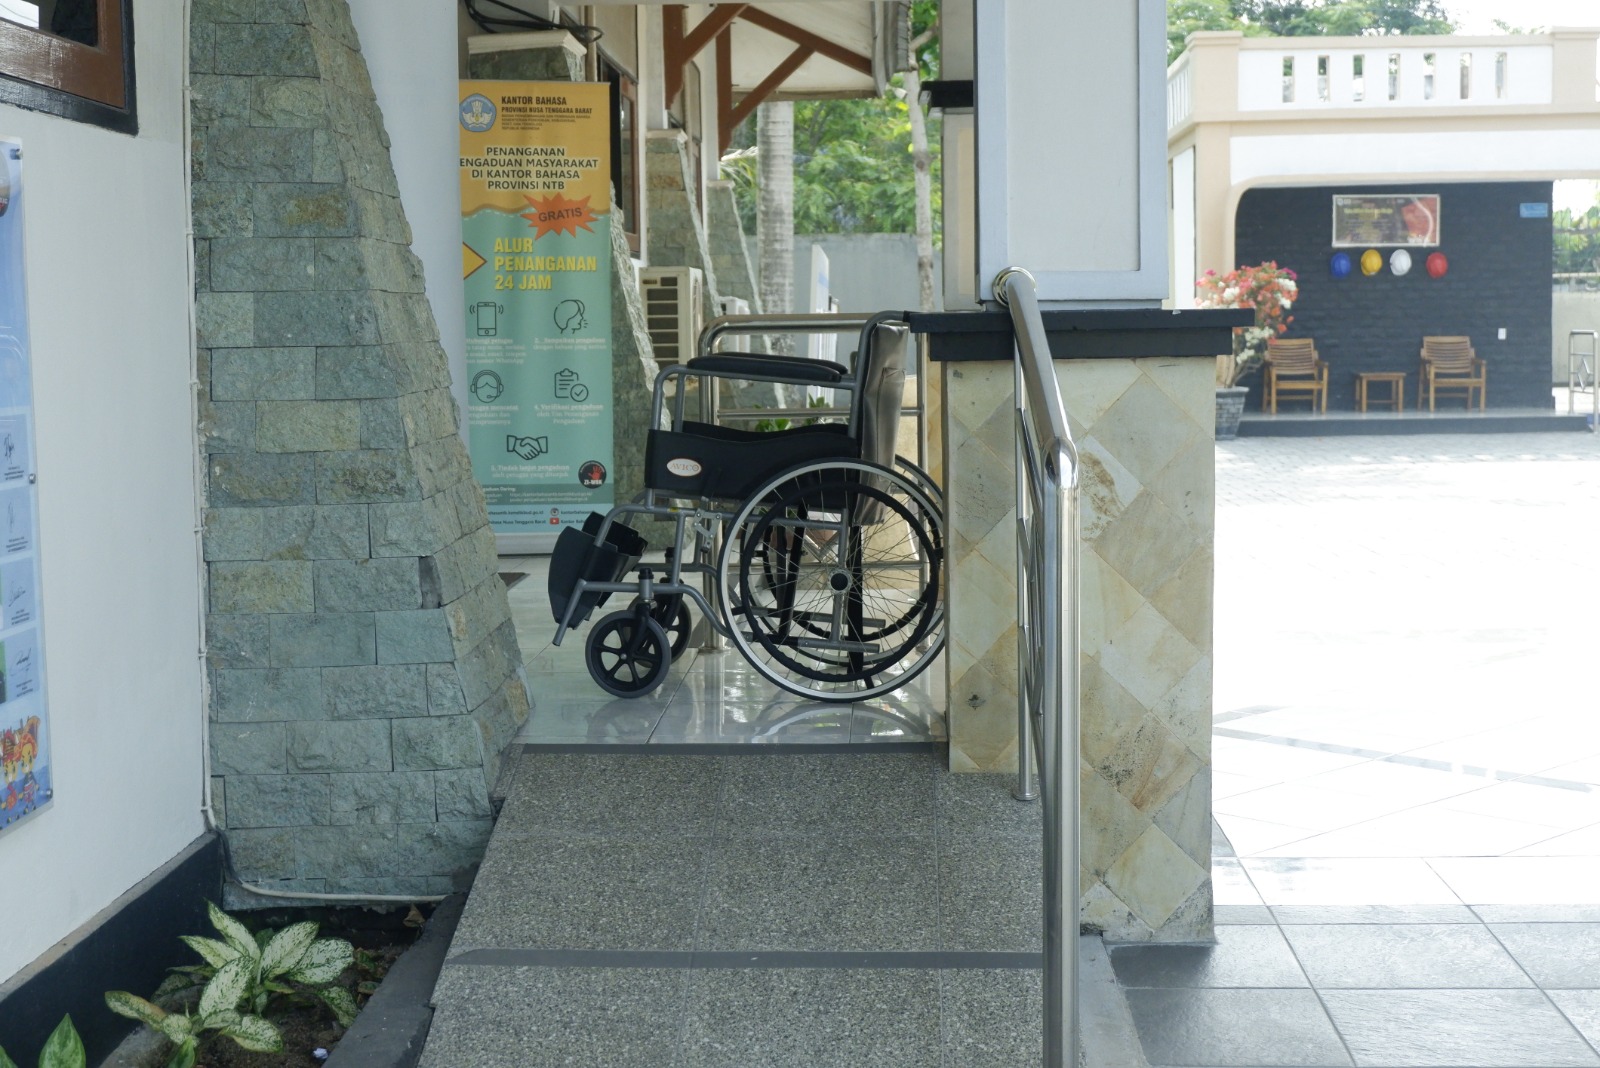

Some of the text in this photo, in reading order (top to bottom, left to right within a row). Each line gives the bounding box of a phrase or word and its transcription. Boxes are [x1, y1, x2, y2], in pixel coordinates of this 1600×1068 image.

[501, 96, 567, 105] KANTOR BAHASA
[486, 147, 565, 156] PENANGANAN
[459, 158, 598, 168] ENGADUAN MASYARAKAT
[472, 169, 580, 179] DI KANTOR BAHASA
[487, 180, 565, 190] PROVINSI NTB
[538, 207, 582, 222] GRATIS
[493, 237, 533, 253] ALUR
[494, 256, 597, 272] PENANGANAN
[495, 275, 552, 290] 24 JAM
